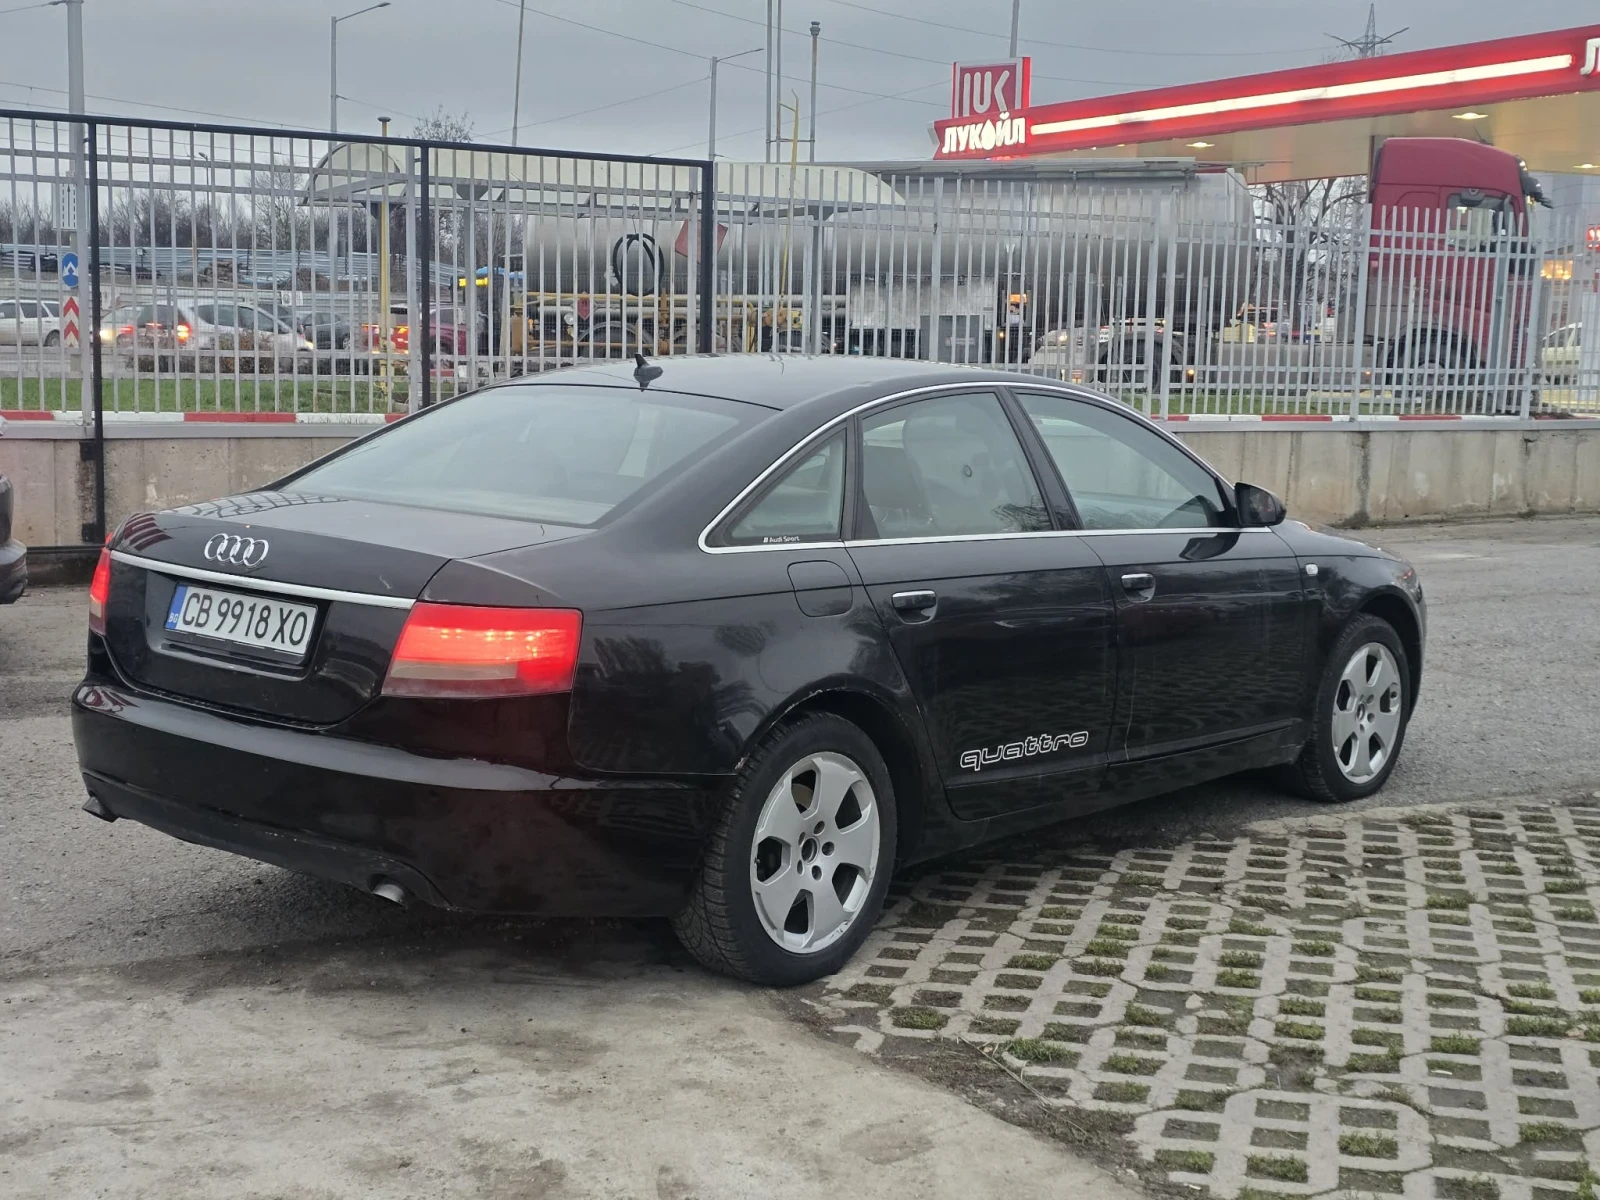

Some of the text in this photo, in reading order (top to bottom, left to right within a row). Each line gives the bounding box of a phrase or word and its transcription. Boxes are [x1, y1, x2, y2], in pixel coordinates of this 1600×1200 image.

[941, 111, 1026, 154] ЛУКОЙЛ
[783, 535, 800, 543] Sport
[168, 612, 179, 623] BG
[182, 592, 308, 646] CB 9918 XO
[960, 731, 1089, 771] quattro
